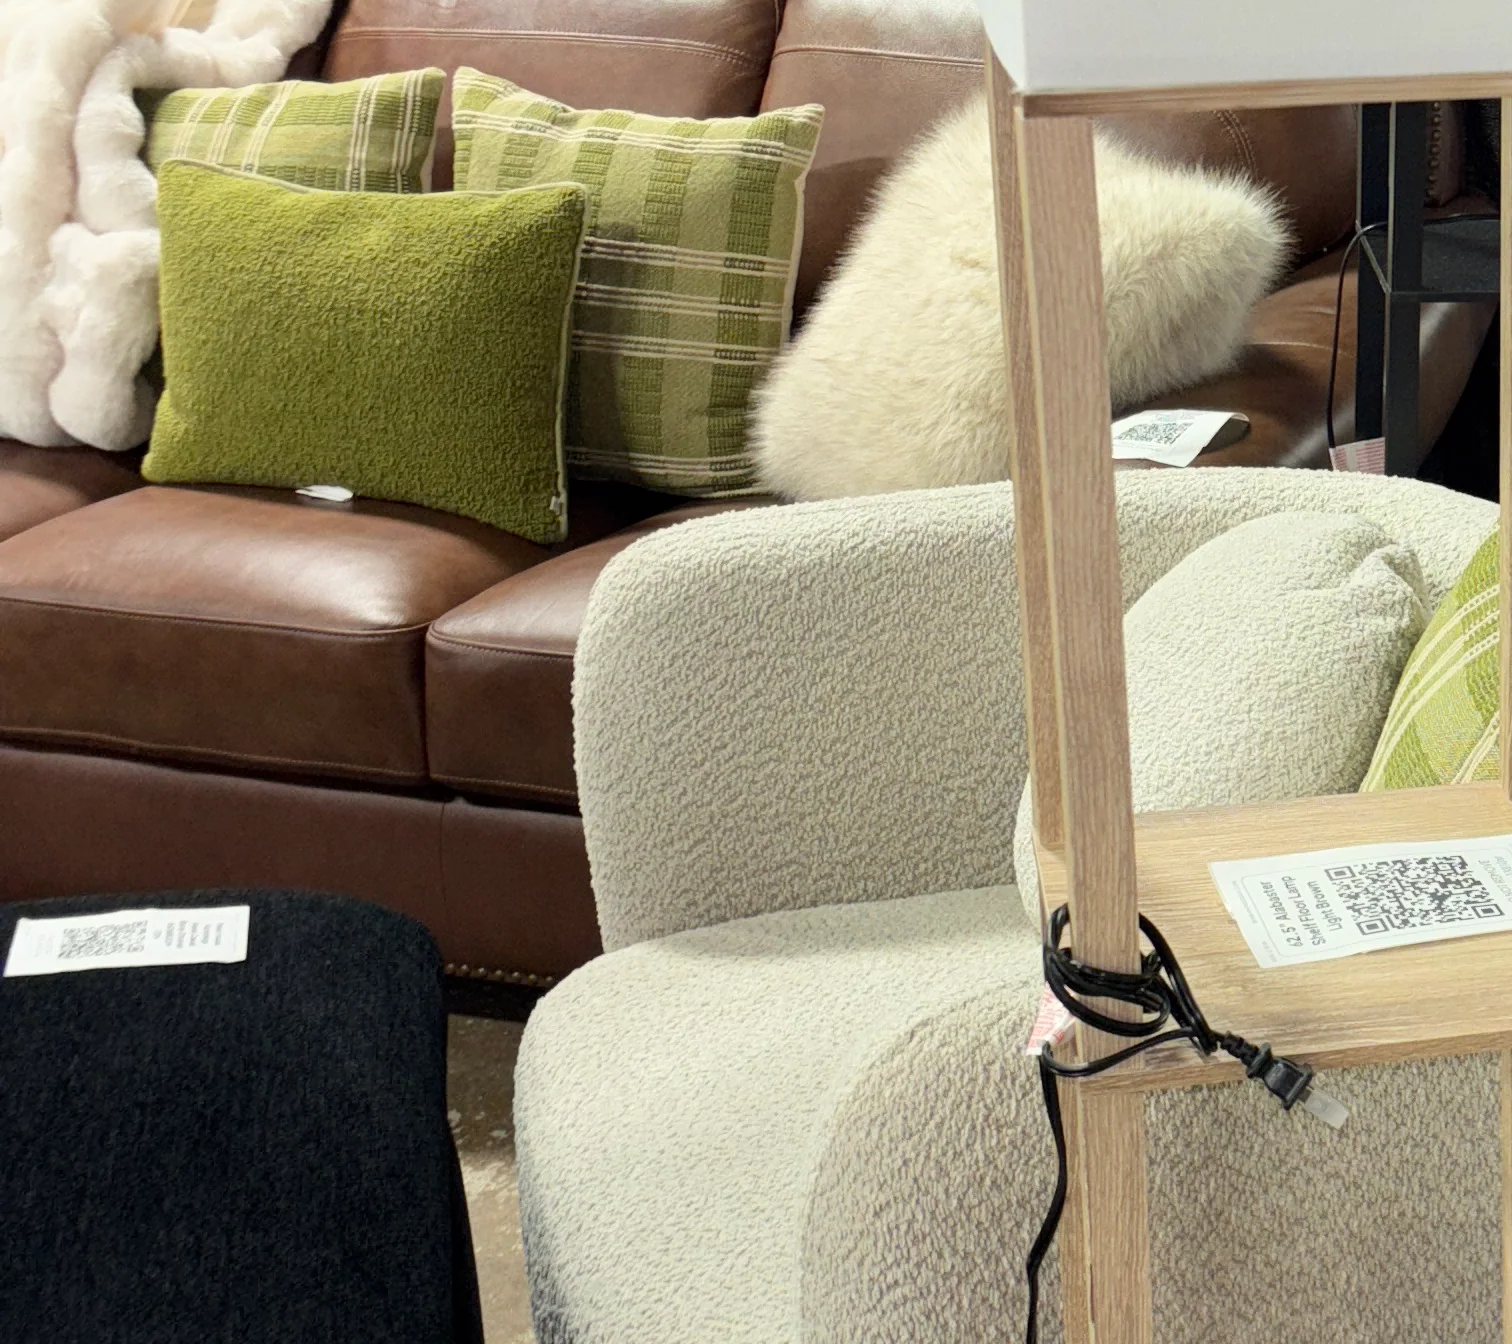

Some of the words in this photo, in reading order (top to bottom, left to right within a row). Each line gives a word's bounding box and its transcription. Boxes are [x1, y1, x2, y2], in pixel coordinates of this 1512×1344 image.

[1281, 876, 1301, 899] Lamp
[1307, 881, 1330, 909] Brown
[1260, 881, 1291, 920] Alabaster
[1294, 900, 1314, 922] Floor
[1321, 909, 1343, 931] Light
[1302, 922, 1326, 946] Shelf
